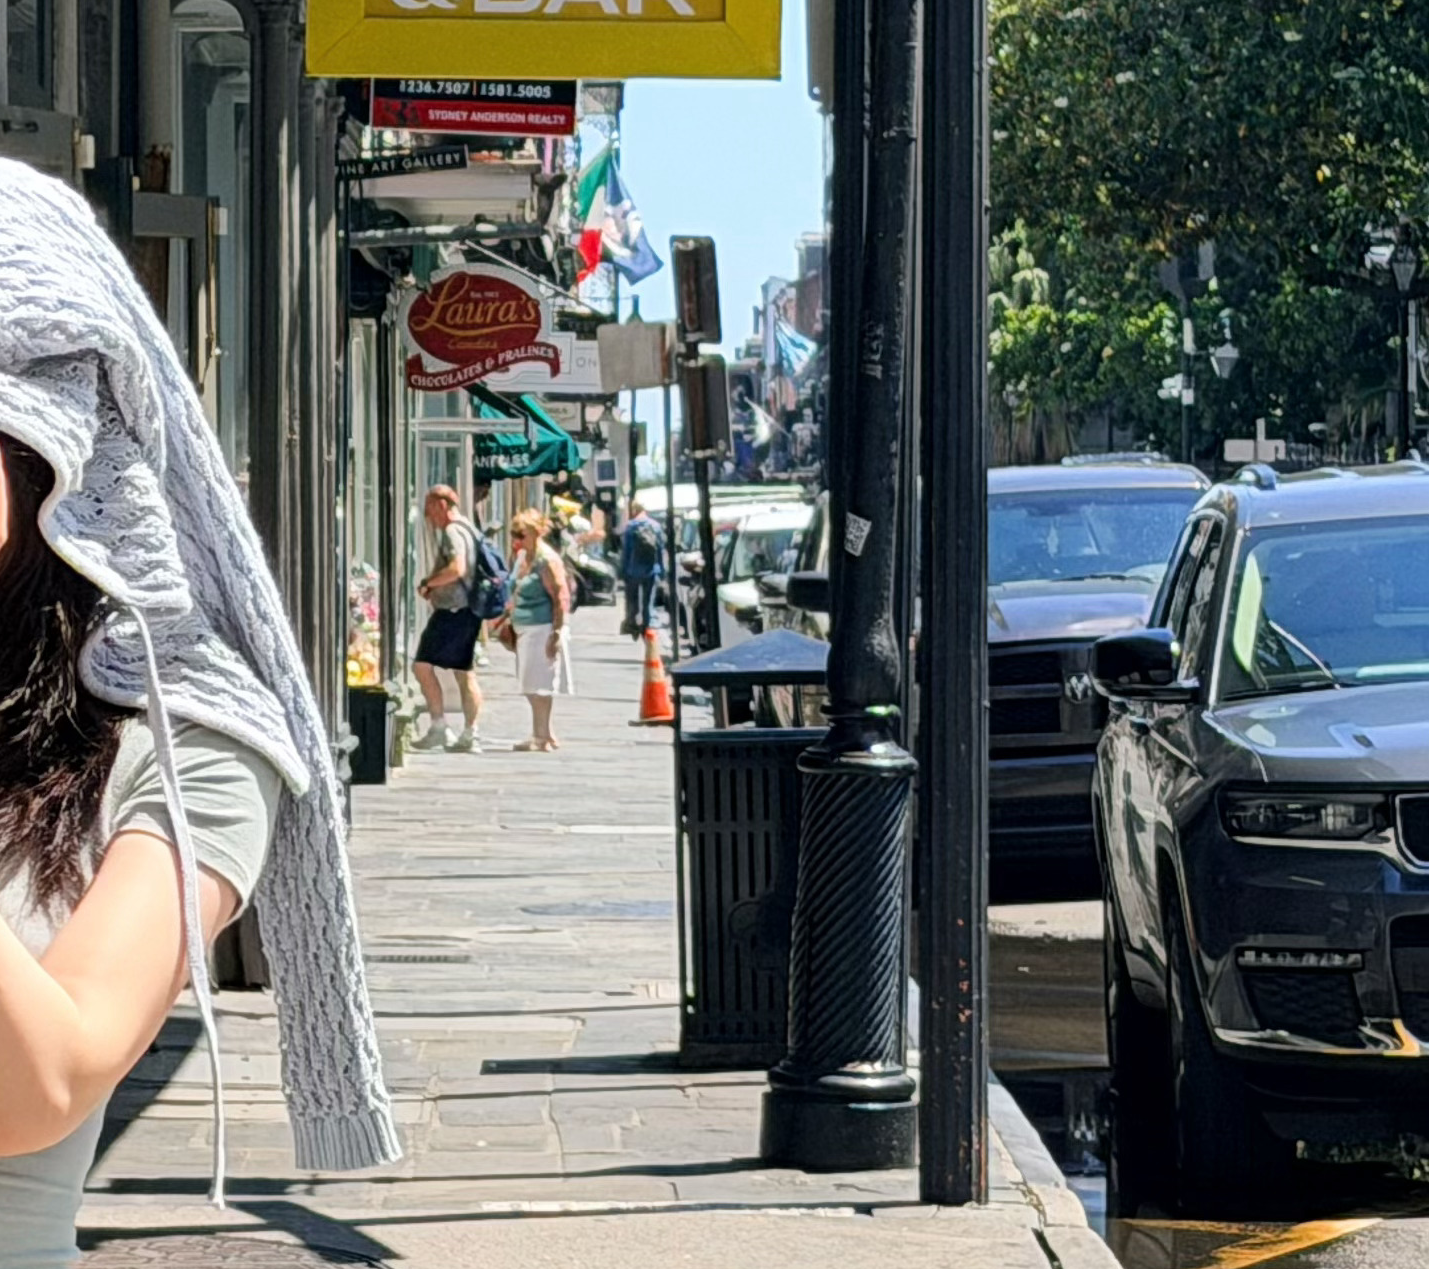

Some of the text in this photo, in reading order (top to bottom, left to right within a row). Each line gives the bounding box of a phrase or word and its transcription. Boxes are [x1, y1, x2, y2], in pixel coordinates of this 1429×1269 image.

[428, 109, 566, 126] SYDNEY ANDERSON REALTY
[402, 153, 460, 169] GALLERY
[410, 275, 538, 336] Laura's
[411, 363, 483, 386] CHOCOLATES
[498, 345, 555, 365] PRALINES
